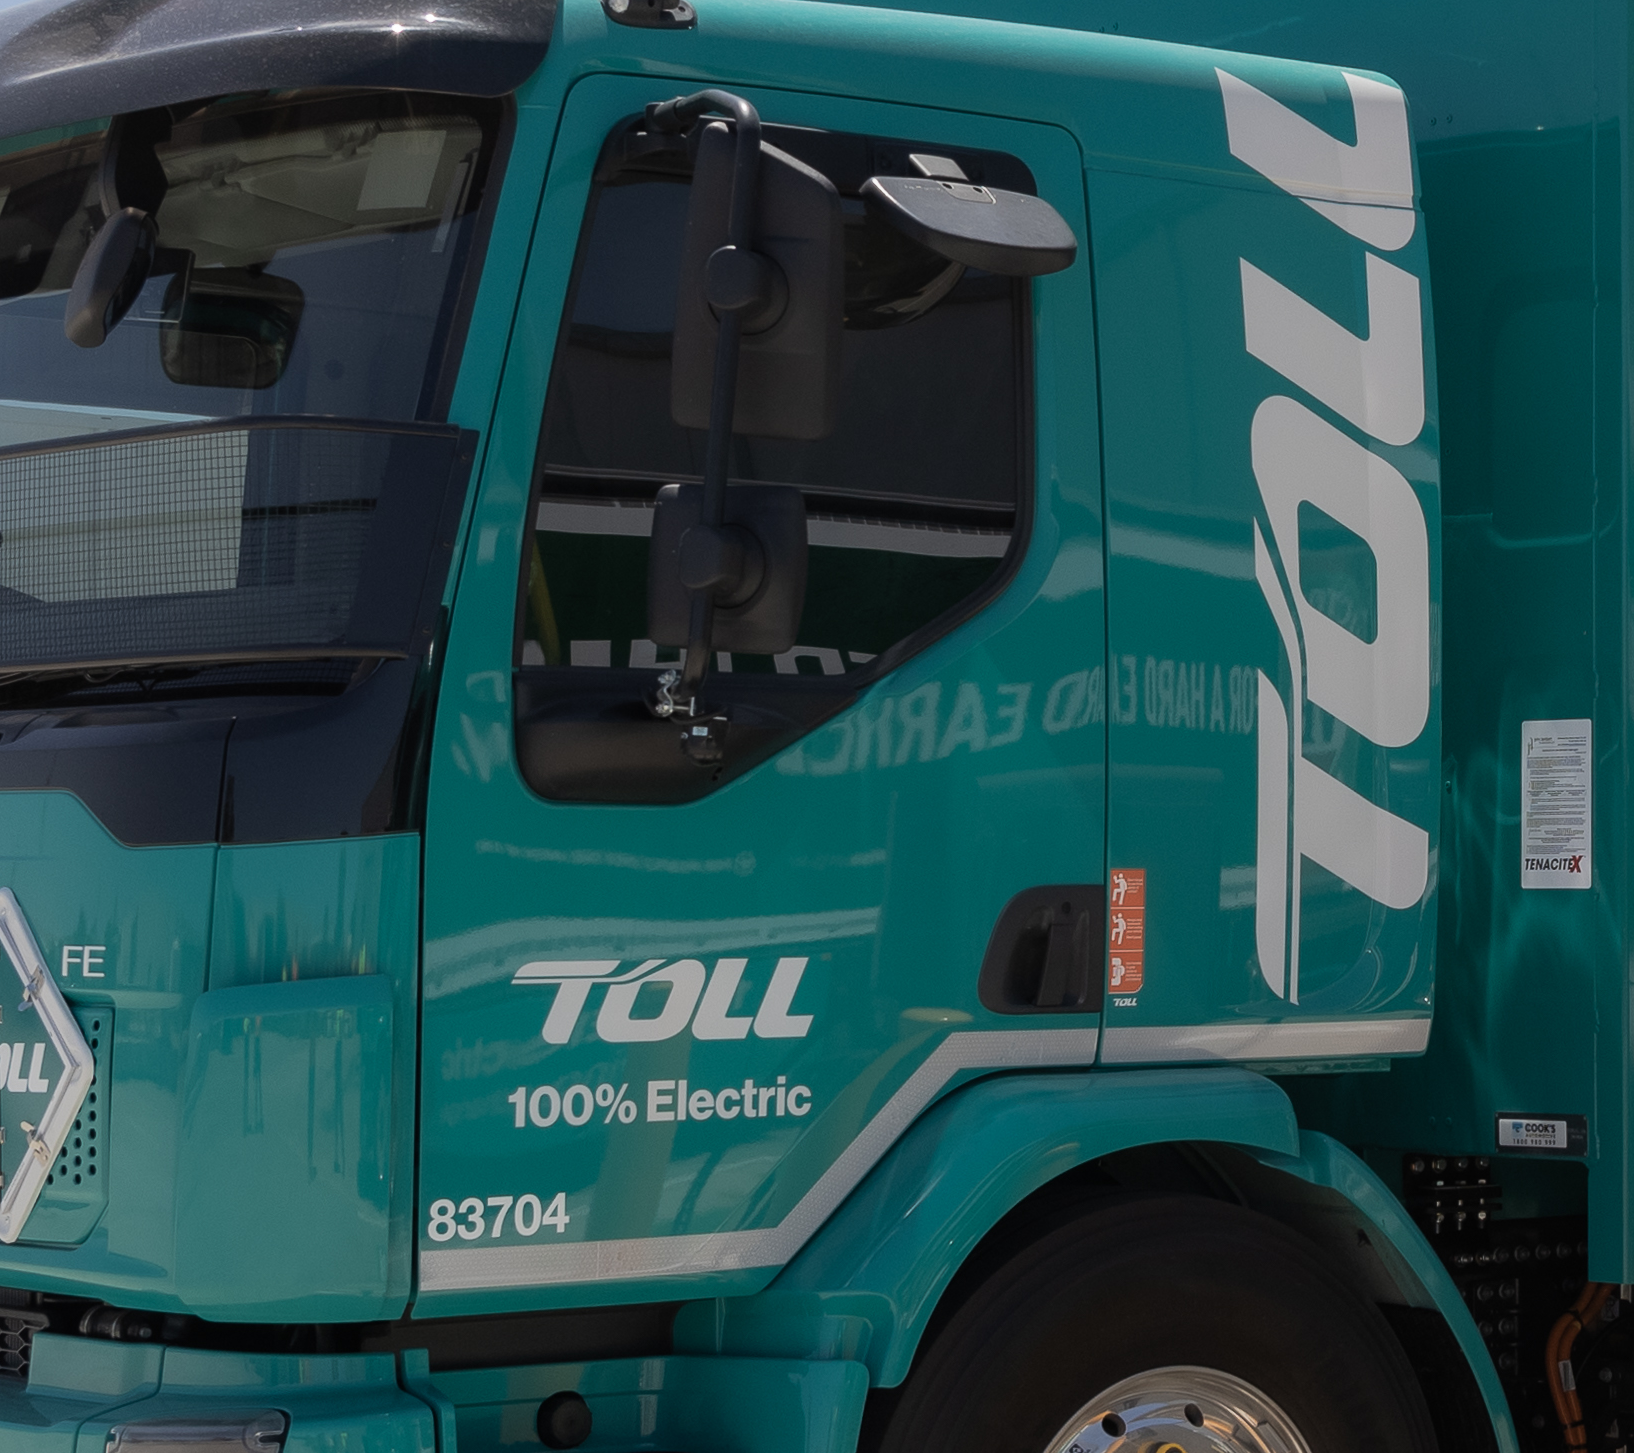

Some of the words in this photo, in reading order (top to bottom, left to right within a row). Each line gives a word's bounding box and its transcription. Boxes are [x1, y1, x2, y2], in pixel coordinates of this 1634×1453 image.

[1214, 66, 1429, 1005] TOLL
[1525, 855, 1583, 874] TENACITEX
[62, 945, 106, 978] FE
[511, 956, 814, 1045] TOLL
[1113, 997, 1138, 1007] TOLL
[508, 1083, 637, 1128] 100%
[646, 1075, 812, 1123] Electric
[1525, 1123, 1556, 1134] COOK'S
[427, 1192, 570, 1242] 83704
